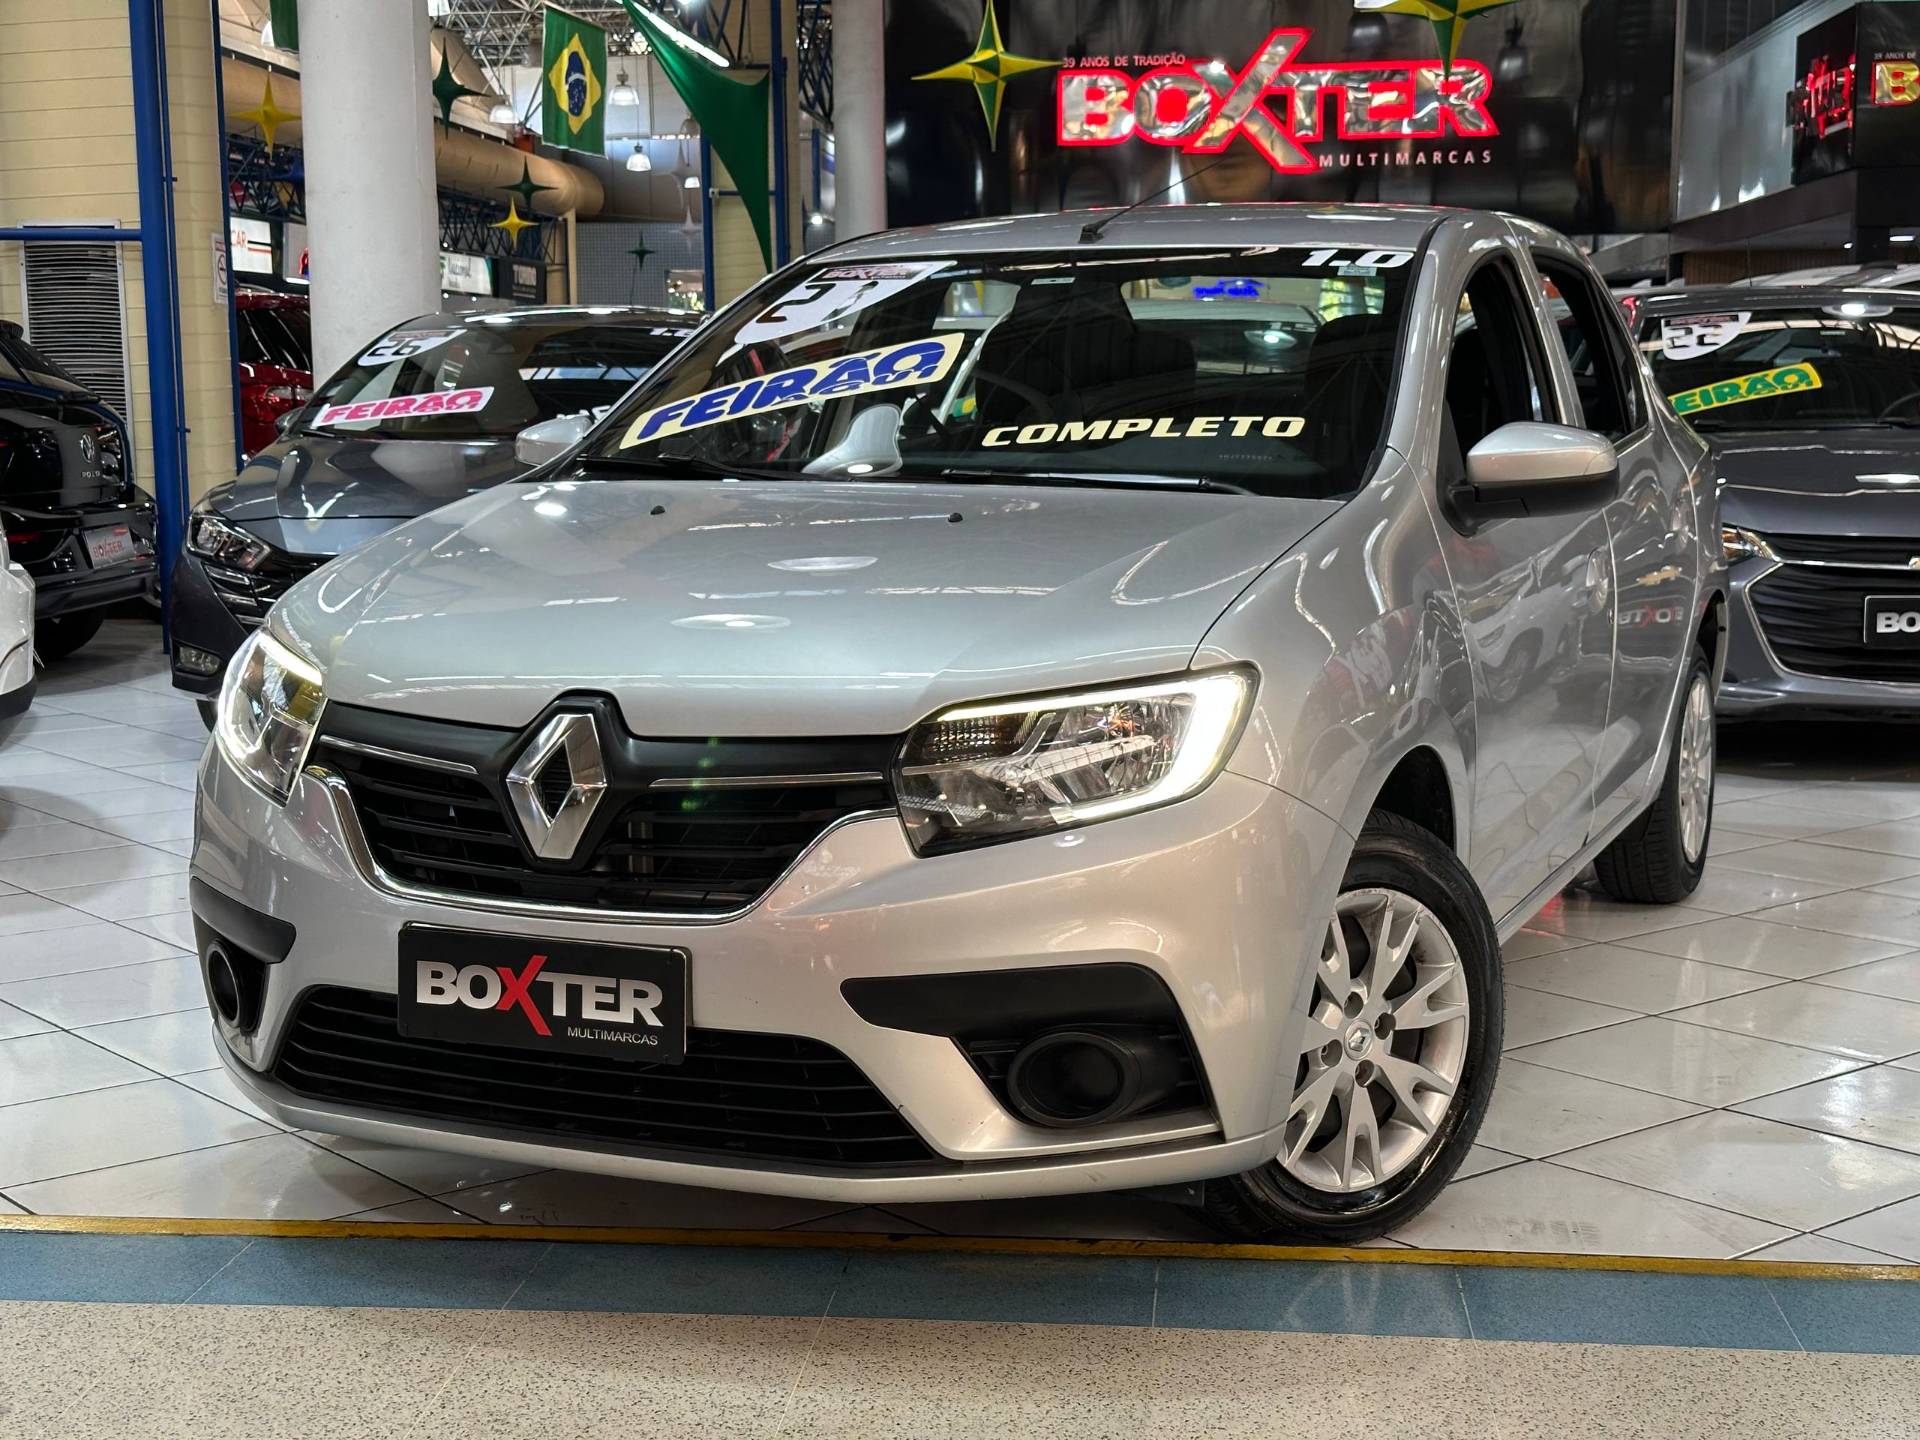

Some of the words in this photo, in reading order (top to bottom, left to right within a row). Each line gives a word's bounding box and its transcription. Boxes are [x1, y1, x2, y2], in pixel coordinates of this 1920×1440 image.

[1080, 57, 1110, 67] ANOS
[1114, 56, 1129, 66] DE
[1133, 51, 1186, 67] TRADIÇÃO
[1871, 61, 1920, 106] B
[1056, 27, 1499, 175] BOXTER
[1318, 149, 1493, 168] MULTIMARCAS
[1301, 249, 1415, 268] 1.0
[366, 338, 425, 357] 26
[637, 341, 946, 441] FEIRÃO
[1672, 367, 1815, 413] EIRÃO
[321, 390, 484, 424] FEIRÃO
[981, 416, 1306, 447] COMPLETO
[1876, 611, 1920, 634] BO
[416, 954, 665, 1037] BOXTER
[567, 1026, 658, 1046] MULTIMARCAS
